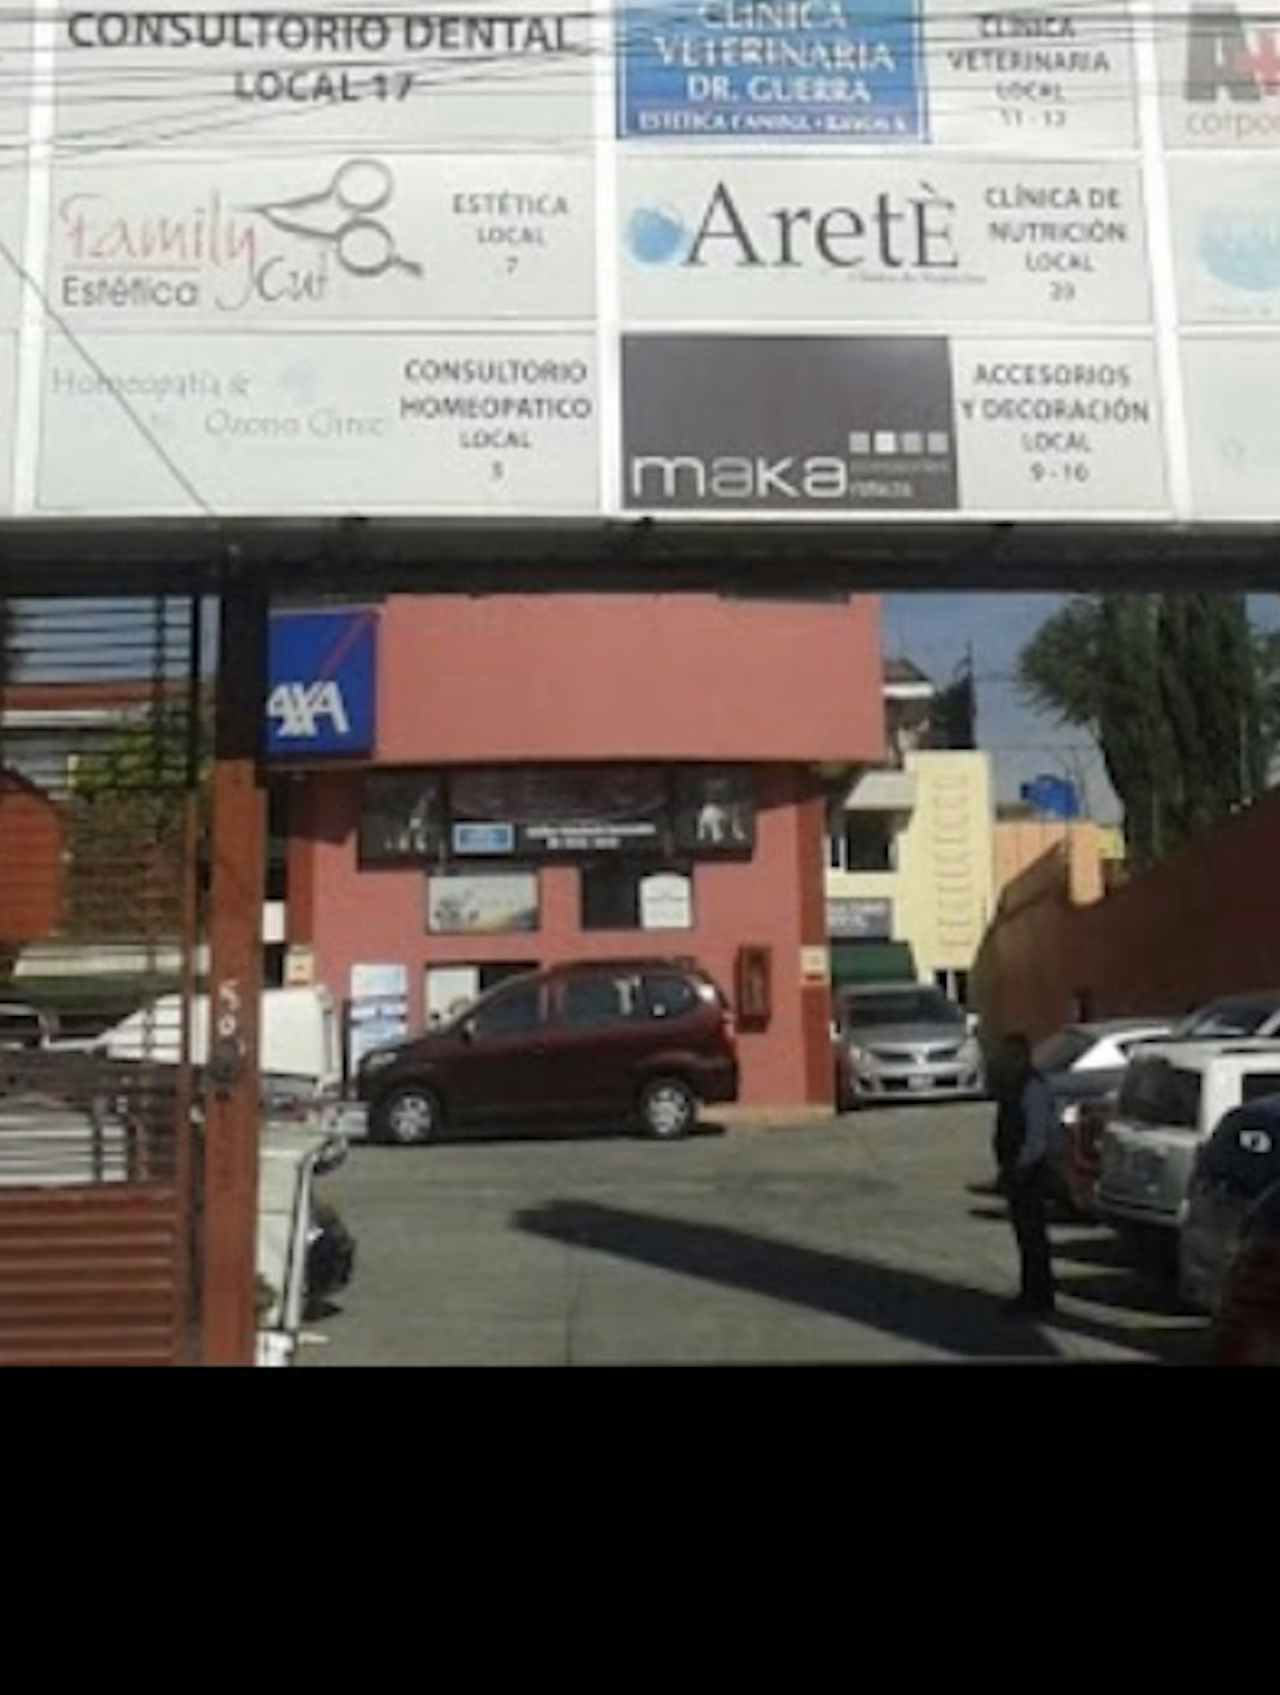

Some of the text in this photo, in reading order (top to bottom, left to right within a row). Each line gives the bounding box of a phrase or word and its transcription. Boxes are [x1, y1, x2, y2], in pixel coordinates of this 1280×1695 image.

[68, 11, 570, 51] CONSULTORIO DENTAL
[947, 51, 1111, 72] VETERINARIA
[234, 70, 415, 101] LOCAL 17
[687, 74, 871, 104] DR. GUERRA
[995, 81, 1065, 103] LOCAL
[452, 189, 569, 215] ESTÉTICA
[985, 183, 1121, 210] CLÍNICA DE
[477, 225, 546, 245] LOCAL
[989, 219, 1127, 244] NUTRICIÓN
[505, 255, 519, 275] 7
[1025, 252, 1095, 273] LOCAL
[404, 357, 588, 384] CONSULTORIO
[974, 363, 1132, 388] ACCESORIOS
[960, 396, 1151, 425] Y DECORACIÓN
[458, 429, 531, 450] LOCAL
[1021, 431, 1092, 454] LOCAL
[631, 455, 848, 499] maka
